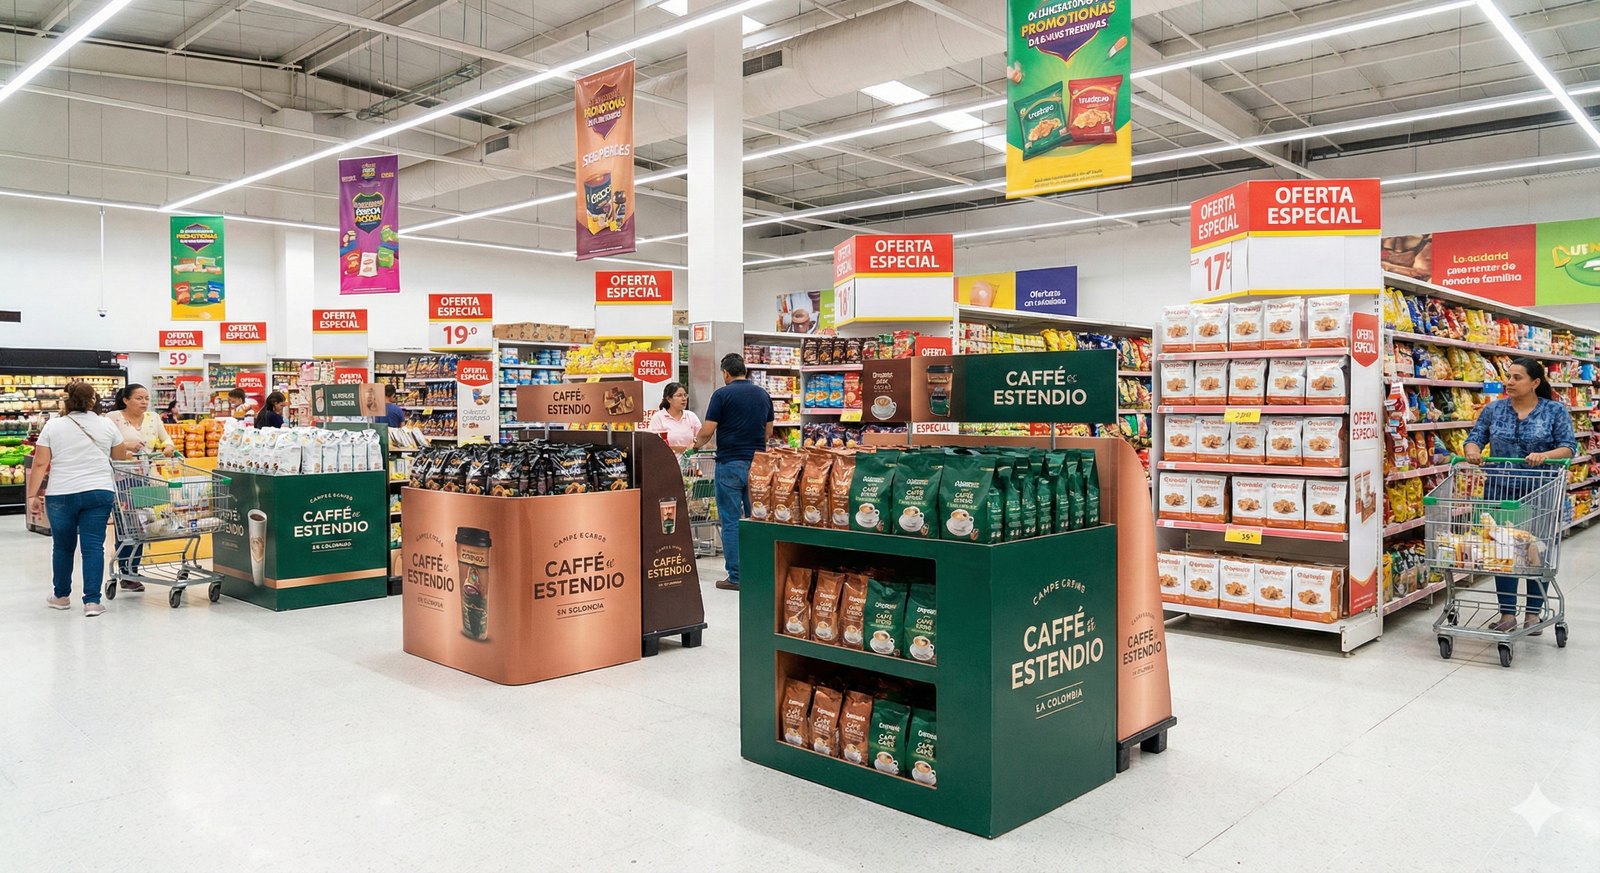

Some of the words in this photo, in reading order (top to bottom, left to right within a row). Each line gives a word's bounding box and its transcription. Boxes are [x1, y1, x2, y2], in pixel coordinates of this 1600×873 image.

[1021, 1, 1116, 37] PROMOTIONAS
[1275, 186, 1354, 204] OFERTA
[1201, 194, 1235, 220] OFERTA
[1267, 207, 1362, 225] ESPECIAL
[1198, 213, 1239, 240] ESPECIAL
[875, 239, 934, 253] OFERTA
[870, 255, 940, 268] ESPECIAL
[610, 275, 657, 286] OFERTA
[606, 287, 662, 298] ESPECIAL
[440, 296, 480, 306] OFERTA
[322, 311, 357, 320] OFERTA
[437, 307, 484, 316] ESPECIAL
[228, 324, 258, 332] OFERTA
[319, 320, 360, 329] ESPECIAL
[921, 347, 947, 356] OFERTA
[637, 368, 669, 376] ESPECIAL
[640, 360, 666, 368] OFERTA
[460, 373, 490, 381] ESPECIAL
[1006, 365, 1066, 387] CAFFÉ
[552, 388, 581, 401] CAFFÉ
[994, 388, 1087, 406] ESTENDIO
[547, 403, 591, 415] ESTENDIO
[1353, 410, 1378, 426] OFERTA
[916, 423, 951, 433] ESPECIAL
[1352, 427, 1379, 441] ESPECIAL
[302, 506, 352, 523] CAFFÉ
[294, 520, 369, 538] ESTENDIO
[412, 552, 444, 573] CAFFÉ
[545, 551, 605, 578] CAFFÉ
[653, 553, 682, 568] CAFFÉ
[647, 564, 692, 579] ESTENDIO
[407, 568, 455, 593] ESTENDIO
[534, 572, 625, 600] ESTENDIO
[1033, 580, 1060, 606] CAMPE
[1023, 605, 1085, 652] CAFFÉ
[1127, 626, 1154, 649] CAFFÉ
[1123, 641, 1162, 666] ESTENDIO
[1011, 637, 1104, 690] ESTENDIO
[1047, 688, 1083, 709] COLOMBIA
